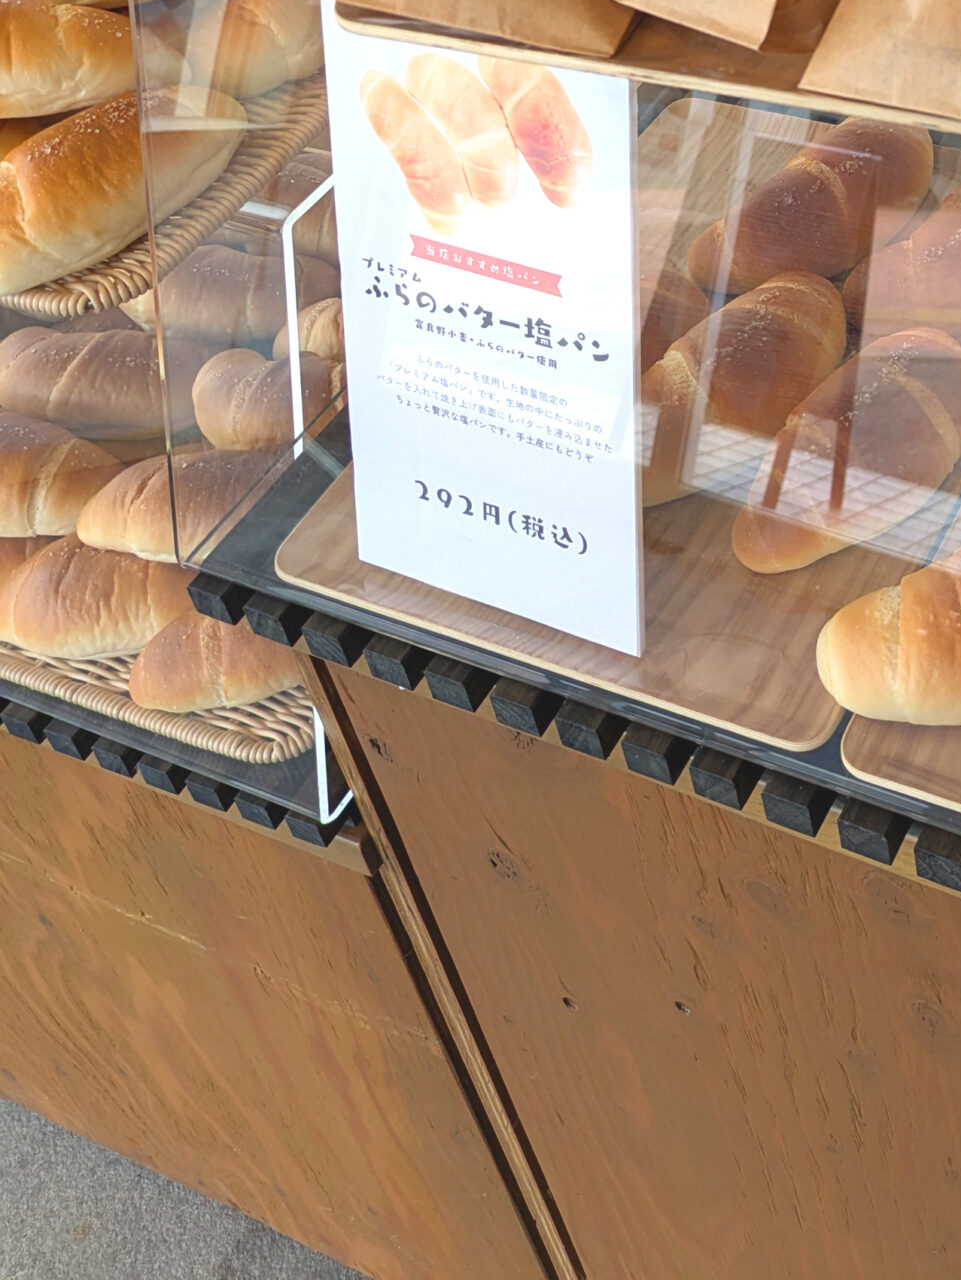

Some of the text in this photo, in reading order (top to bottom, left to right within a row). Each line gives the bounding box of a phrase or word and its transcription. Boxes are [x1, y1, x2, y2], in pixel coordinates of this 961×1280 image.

[362, 256, 422, 283] プレミアム
[425, 244, 540, 285] 当店おすすめ塩パン
[365, 276, 609, 362] ふらのバター塩パン
[416, 355, 568, 408] ふらのバターを使用した数量限定の
[414, 479, 588, 555] 292円(税込)
